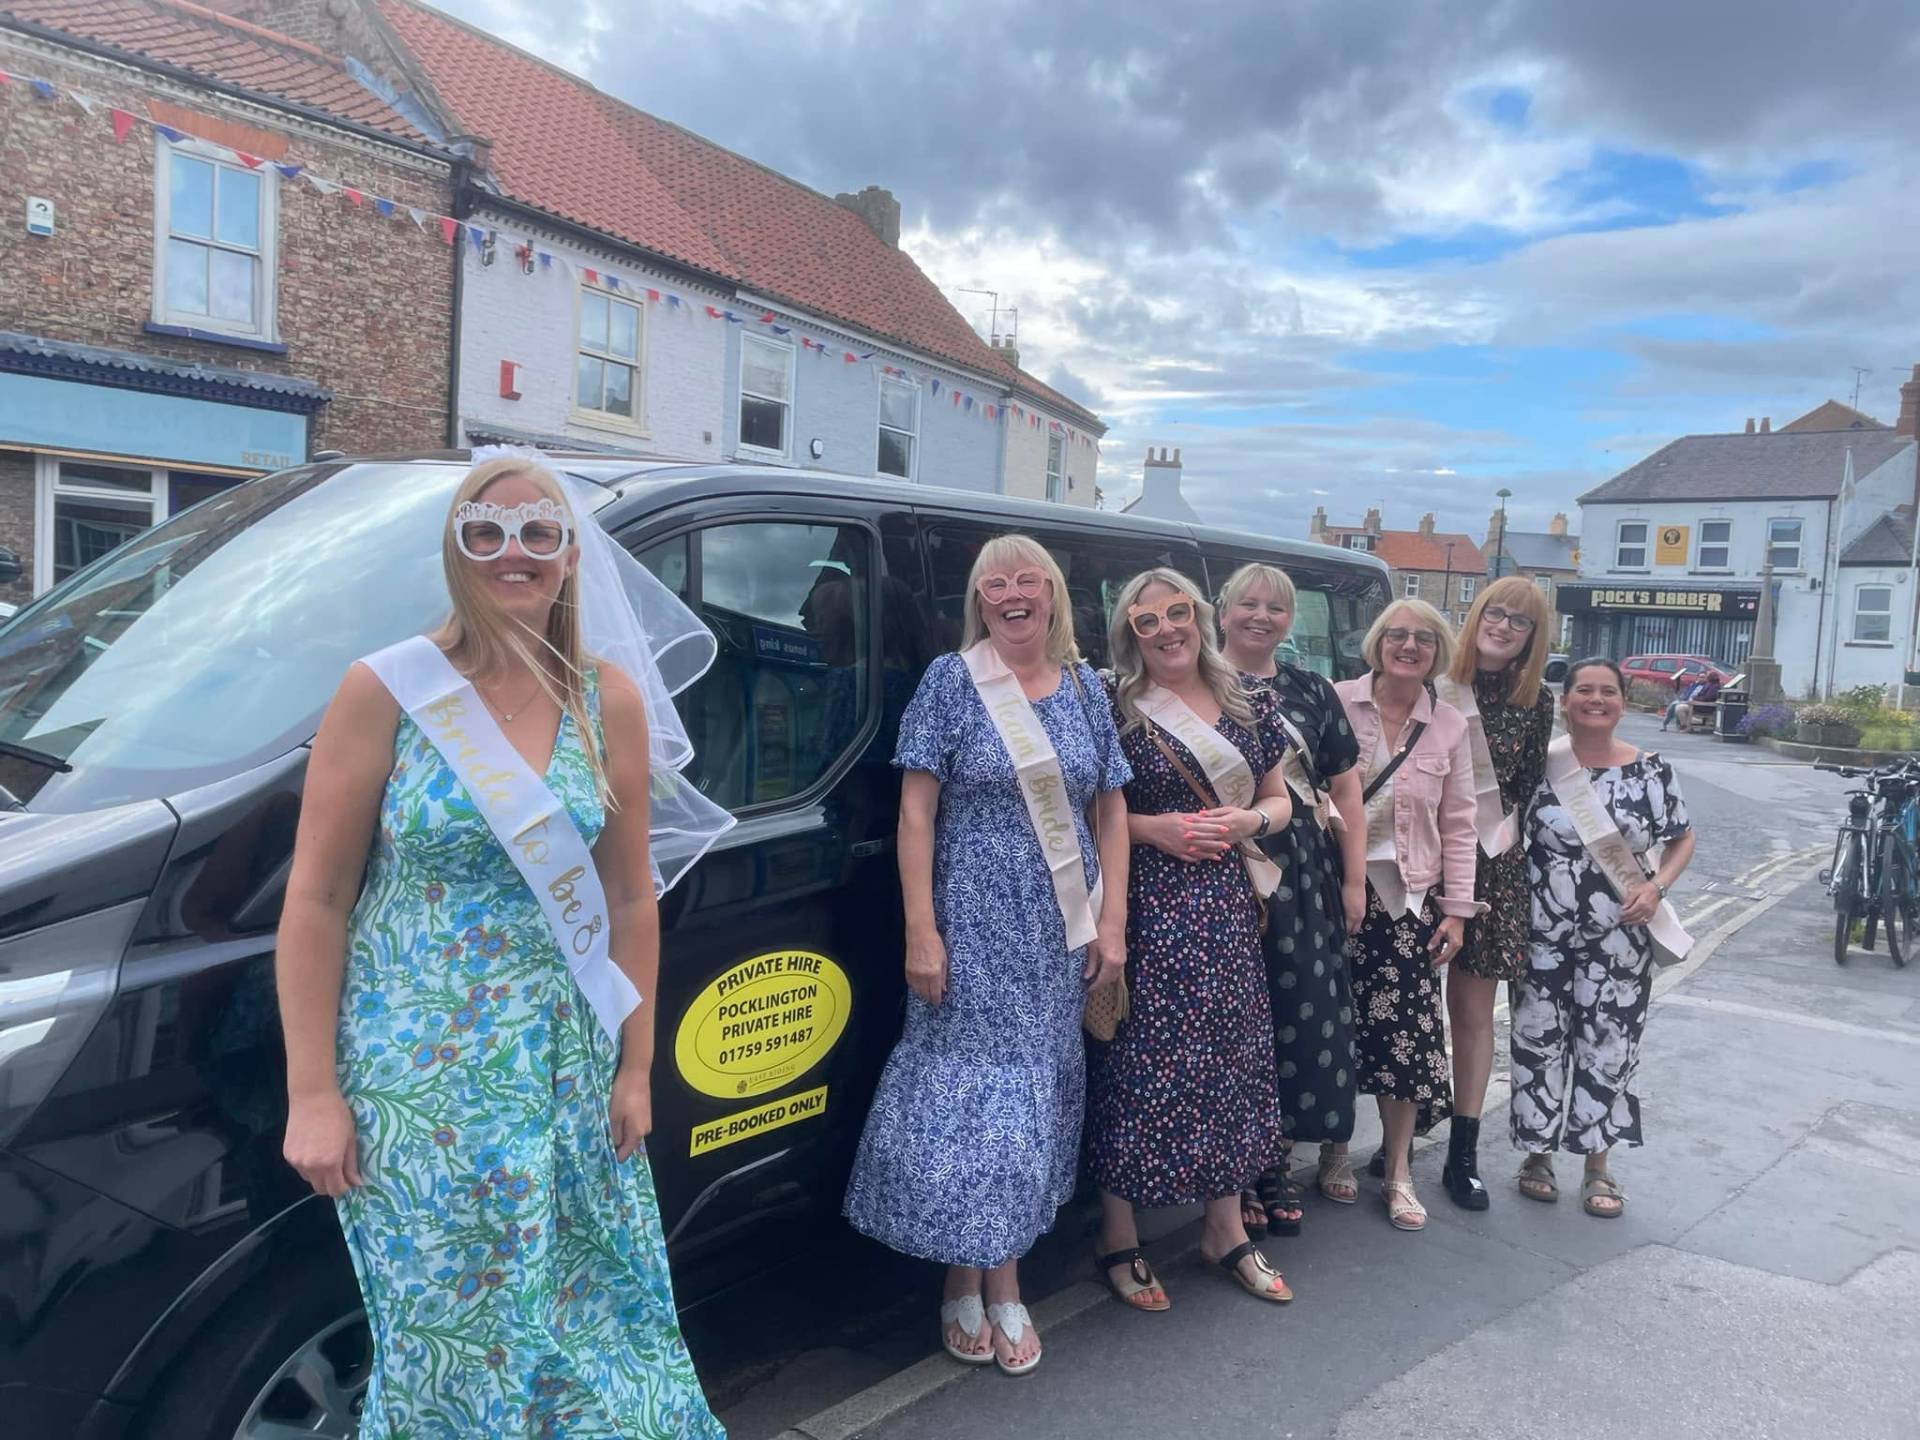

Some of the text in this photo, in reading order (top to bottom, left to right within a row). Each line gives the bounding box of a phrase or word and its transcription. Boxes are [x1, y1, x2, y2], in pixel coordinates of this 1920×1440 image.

[1591, 590, 1722, 612] POCK'S BARBER
[426, 695, 515, 814] Bride
[512, 815, 549, 865] to
[994, 692, 1070, 851] Team Bride
[716, 956, 823, 996] PRIVATE HIRE
[718, 984, 817, 1021] POCKLINGTON
[722, 1005, 813, 1041] PRIVATE HIRE
[719, 1027, 813, 1065] 01759 591487
[695, 1093, 824, 1148] PRE-BOOKED ONLY
